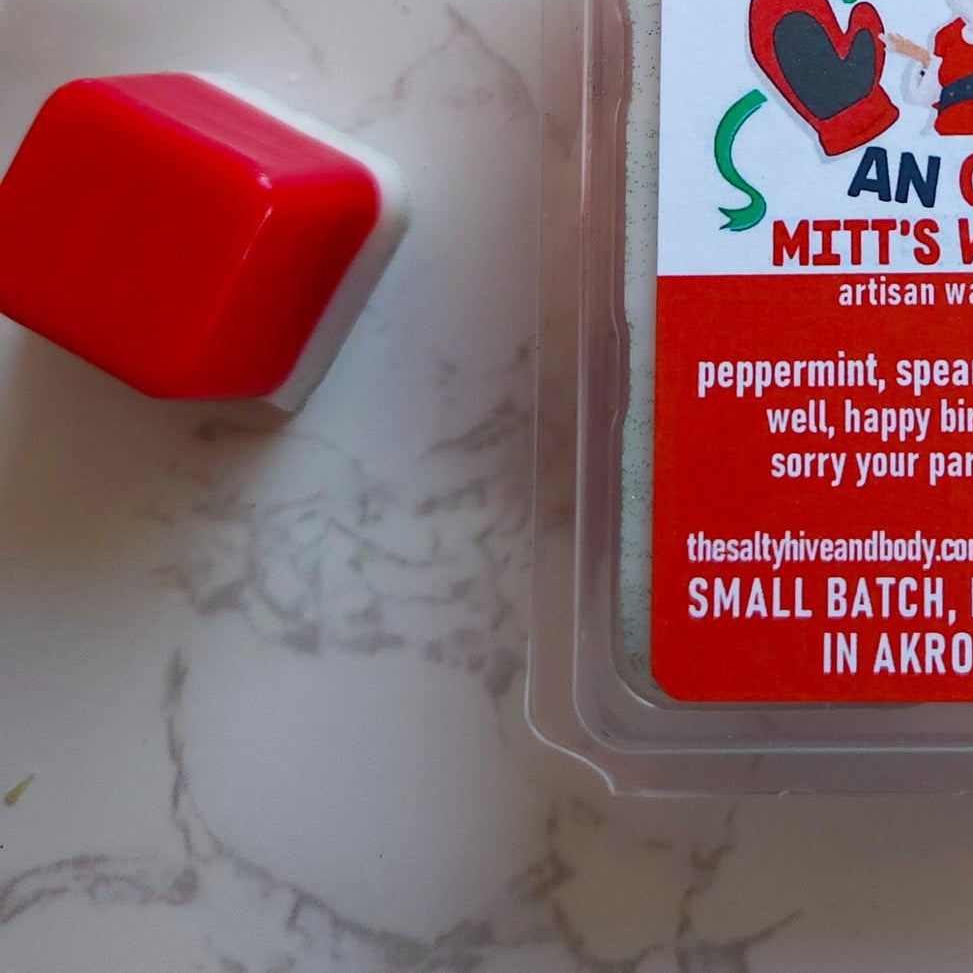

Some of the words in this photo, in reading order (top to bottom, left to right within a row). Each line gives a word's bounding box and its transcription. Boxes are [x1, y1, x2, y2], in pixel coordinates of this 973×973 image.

[847, 146, 941, 208] AN
[773, 218, 940, 266] MITT'S
[839, 277, 934, 305] artisan
[698, 351, 886, 398] peppermint,
[767, 401, 834, 438] well,
[845, 400, 930, 441] happy
[772, 453, 846, 486] sorry
[856, 453, 919, 486] your
[689, 578, 812, 617] SMALL
[828, 577, 955, 625] BATCH,
[824, 633, 857, 673] IN
